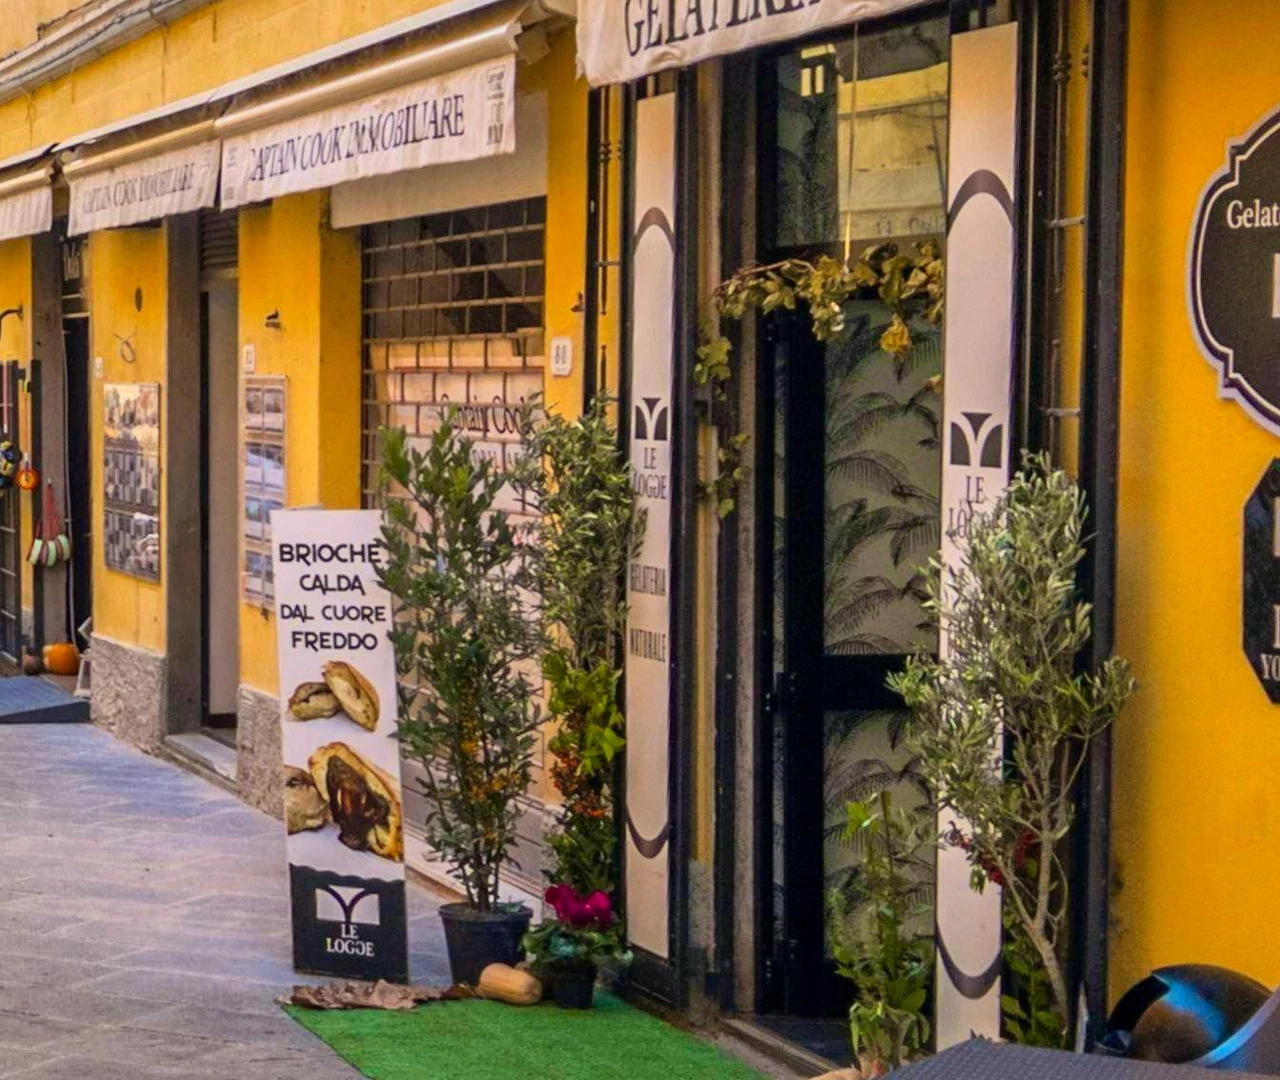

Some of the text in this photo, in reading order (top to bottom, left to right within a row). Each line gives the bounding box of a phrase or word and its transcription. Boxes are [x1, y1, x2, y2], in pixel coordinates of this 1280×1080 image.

[300, 124, 346, 171] COOK
[345, 94, 465, 159] IMMOBILIARE
[1226, 199, 1280, 230] Gelat
[643, 447, 657, 470] LE
[965, 475, 986, 505] LE
[279, 543, 382, 567] BRIOCHE
[299, 574, 366, 596] CALDA
[280, 604, 387, 625] DAL CUORE
[291, 631, 379, 652] FREDDO
[341, 923, 359, 939] LE
